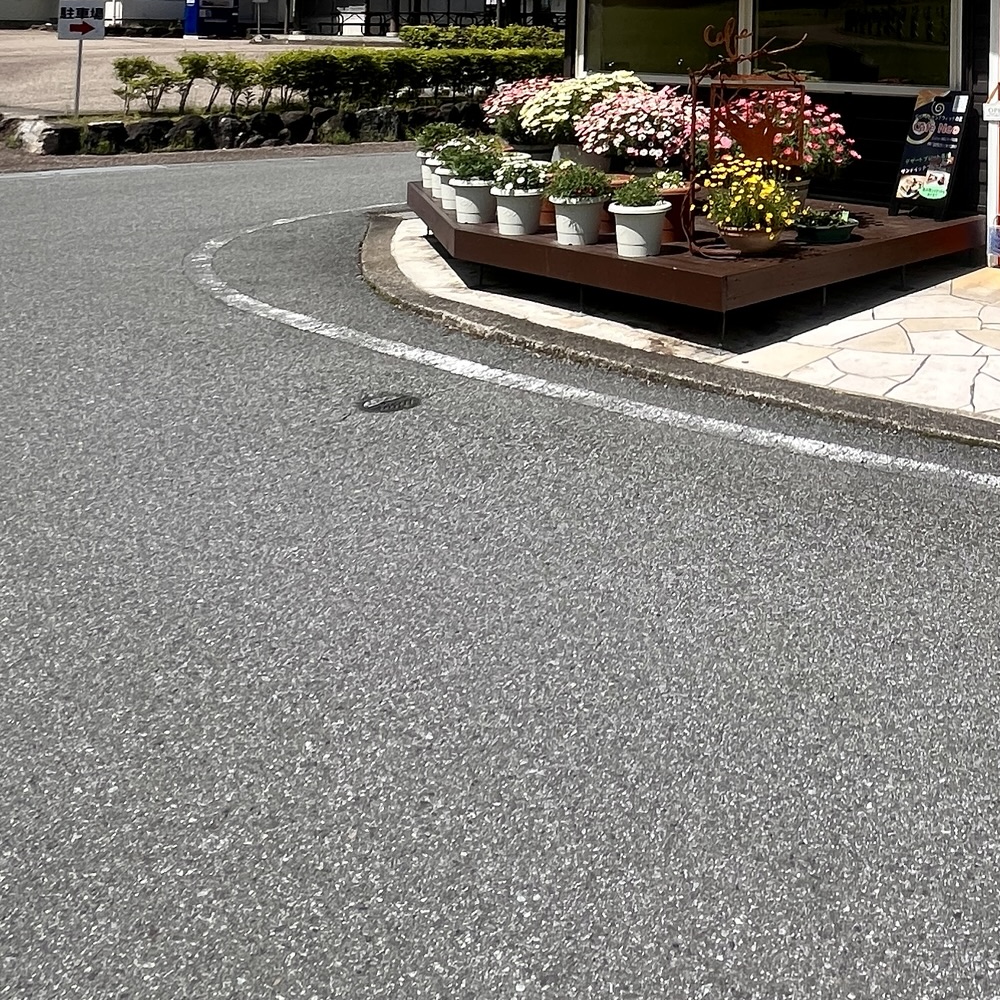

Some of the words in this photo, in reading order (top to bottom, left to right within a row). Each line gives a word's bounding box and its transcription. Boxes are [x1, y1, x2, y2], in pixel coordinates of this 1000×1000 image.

[60, 6, 104, 20] 駐車場
[937, 123, 961, 135] Neo
